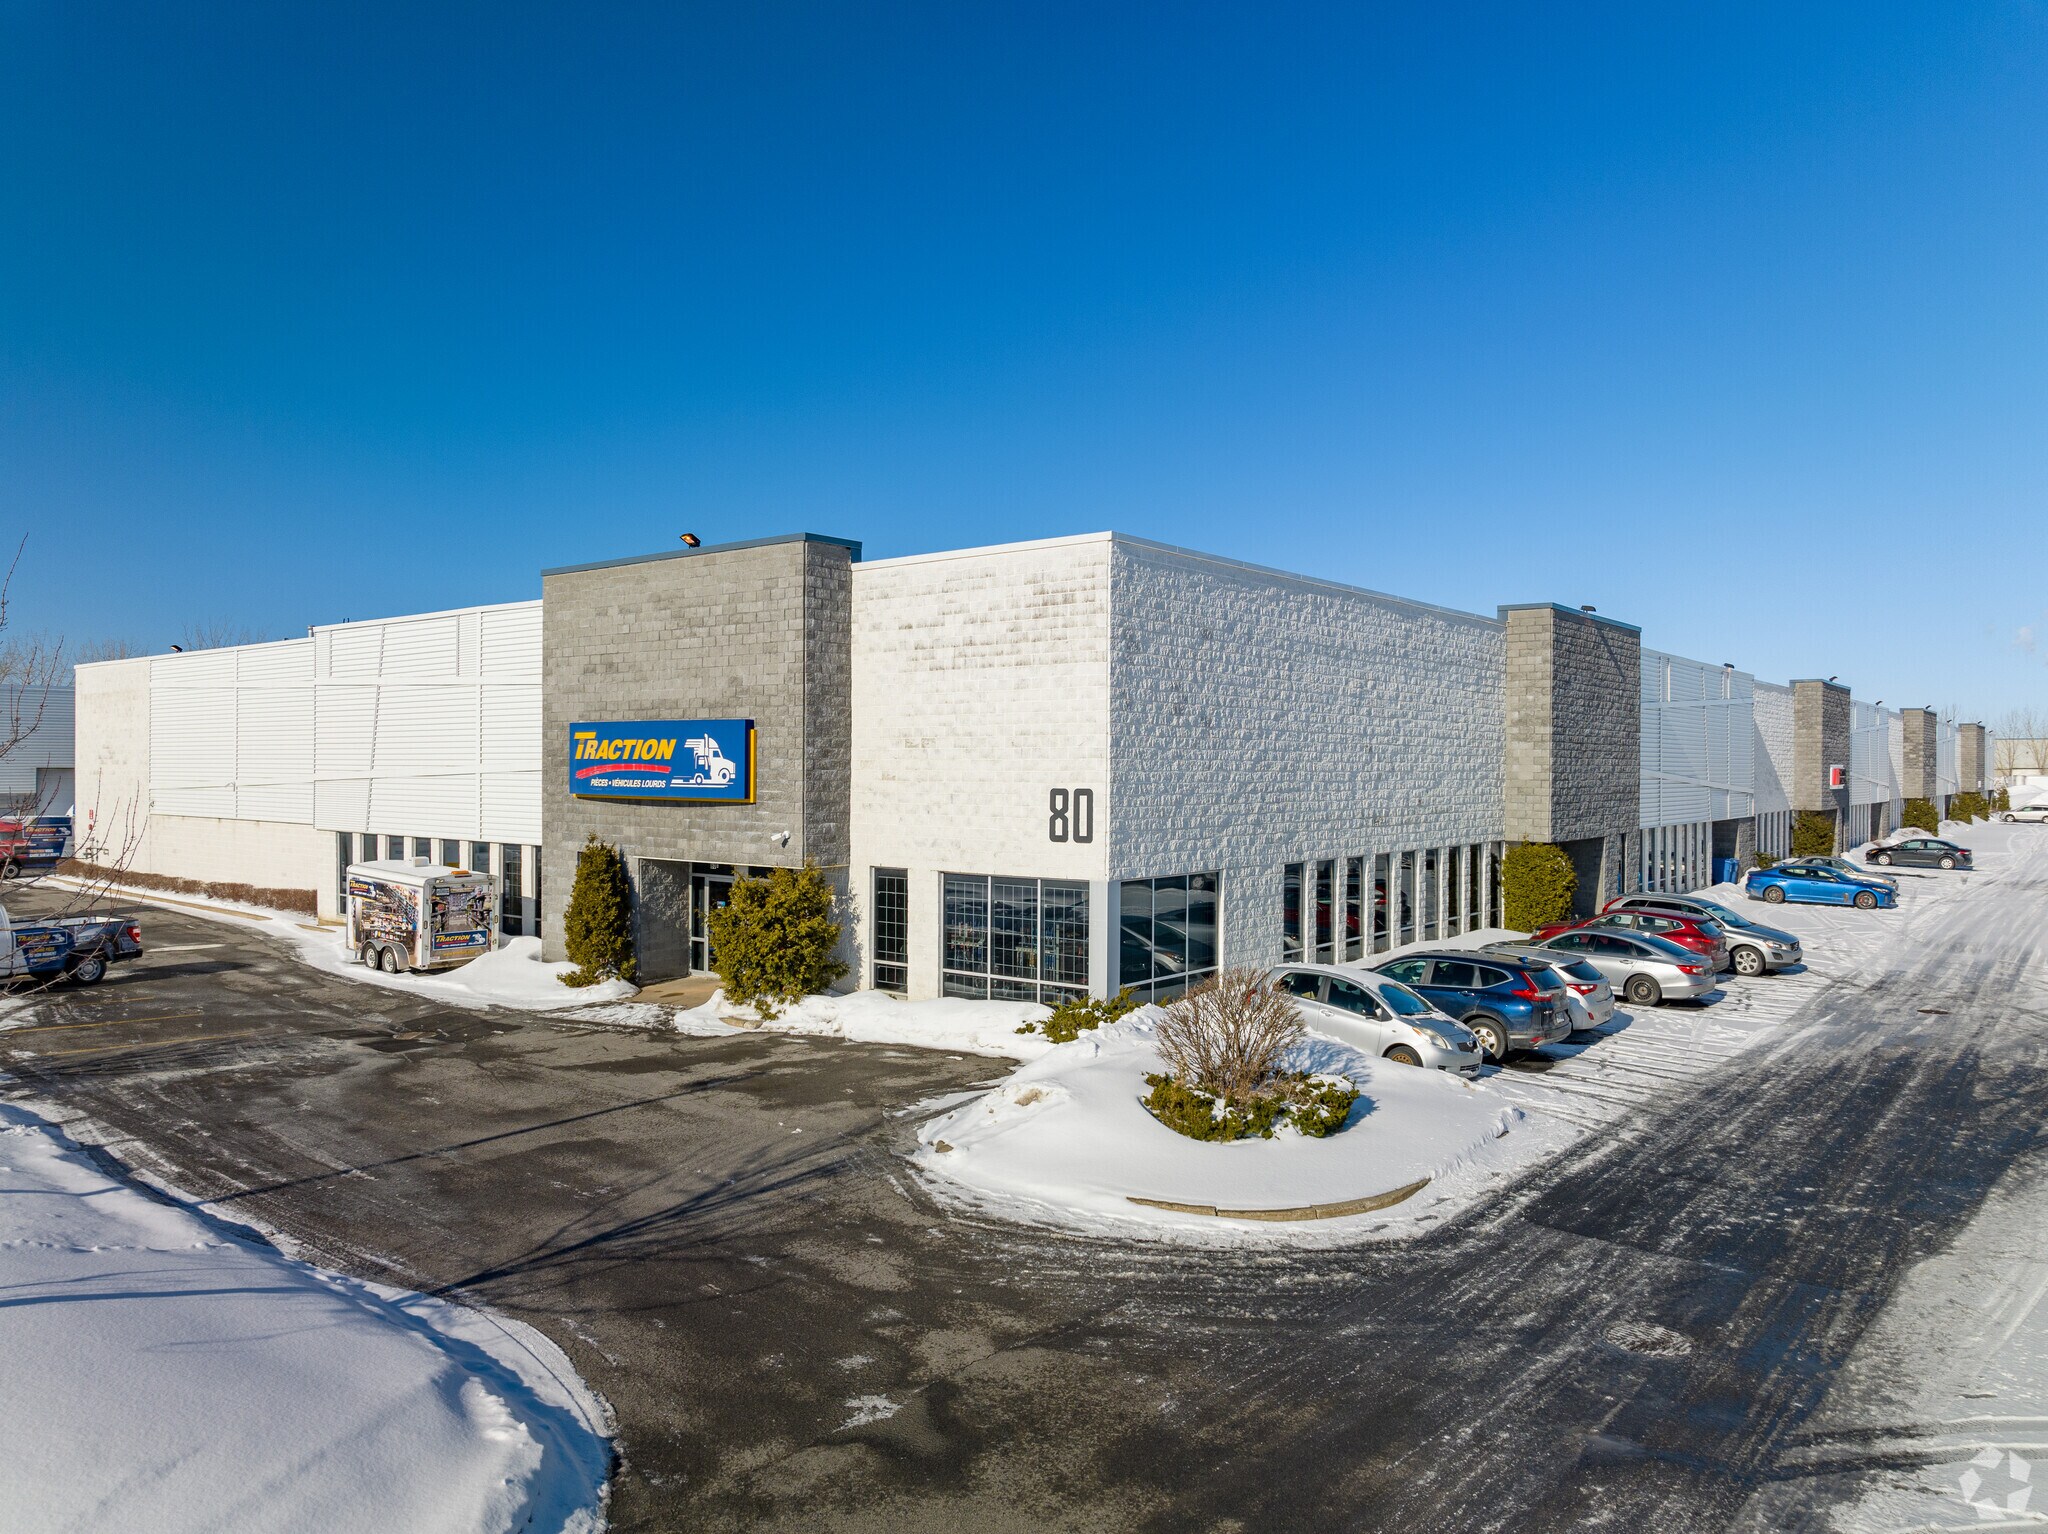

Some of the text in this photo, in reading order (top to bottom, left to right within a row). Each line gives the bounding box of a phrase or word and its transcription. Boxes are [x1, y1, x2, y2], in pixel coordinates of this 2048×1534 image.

[574, 731, 676, 760] TRACTION
[641, 779, 666, 788] LOURDS
[1049, 788, 1093, 843] 80
[435, 934, 470, 943] TRACTION
